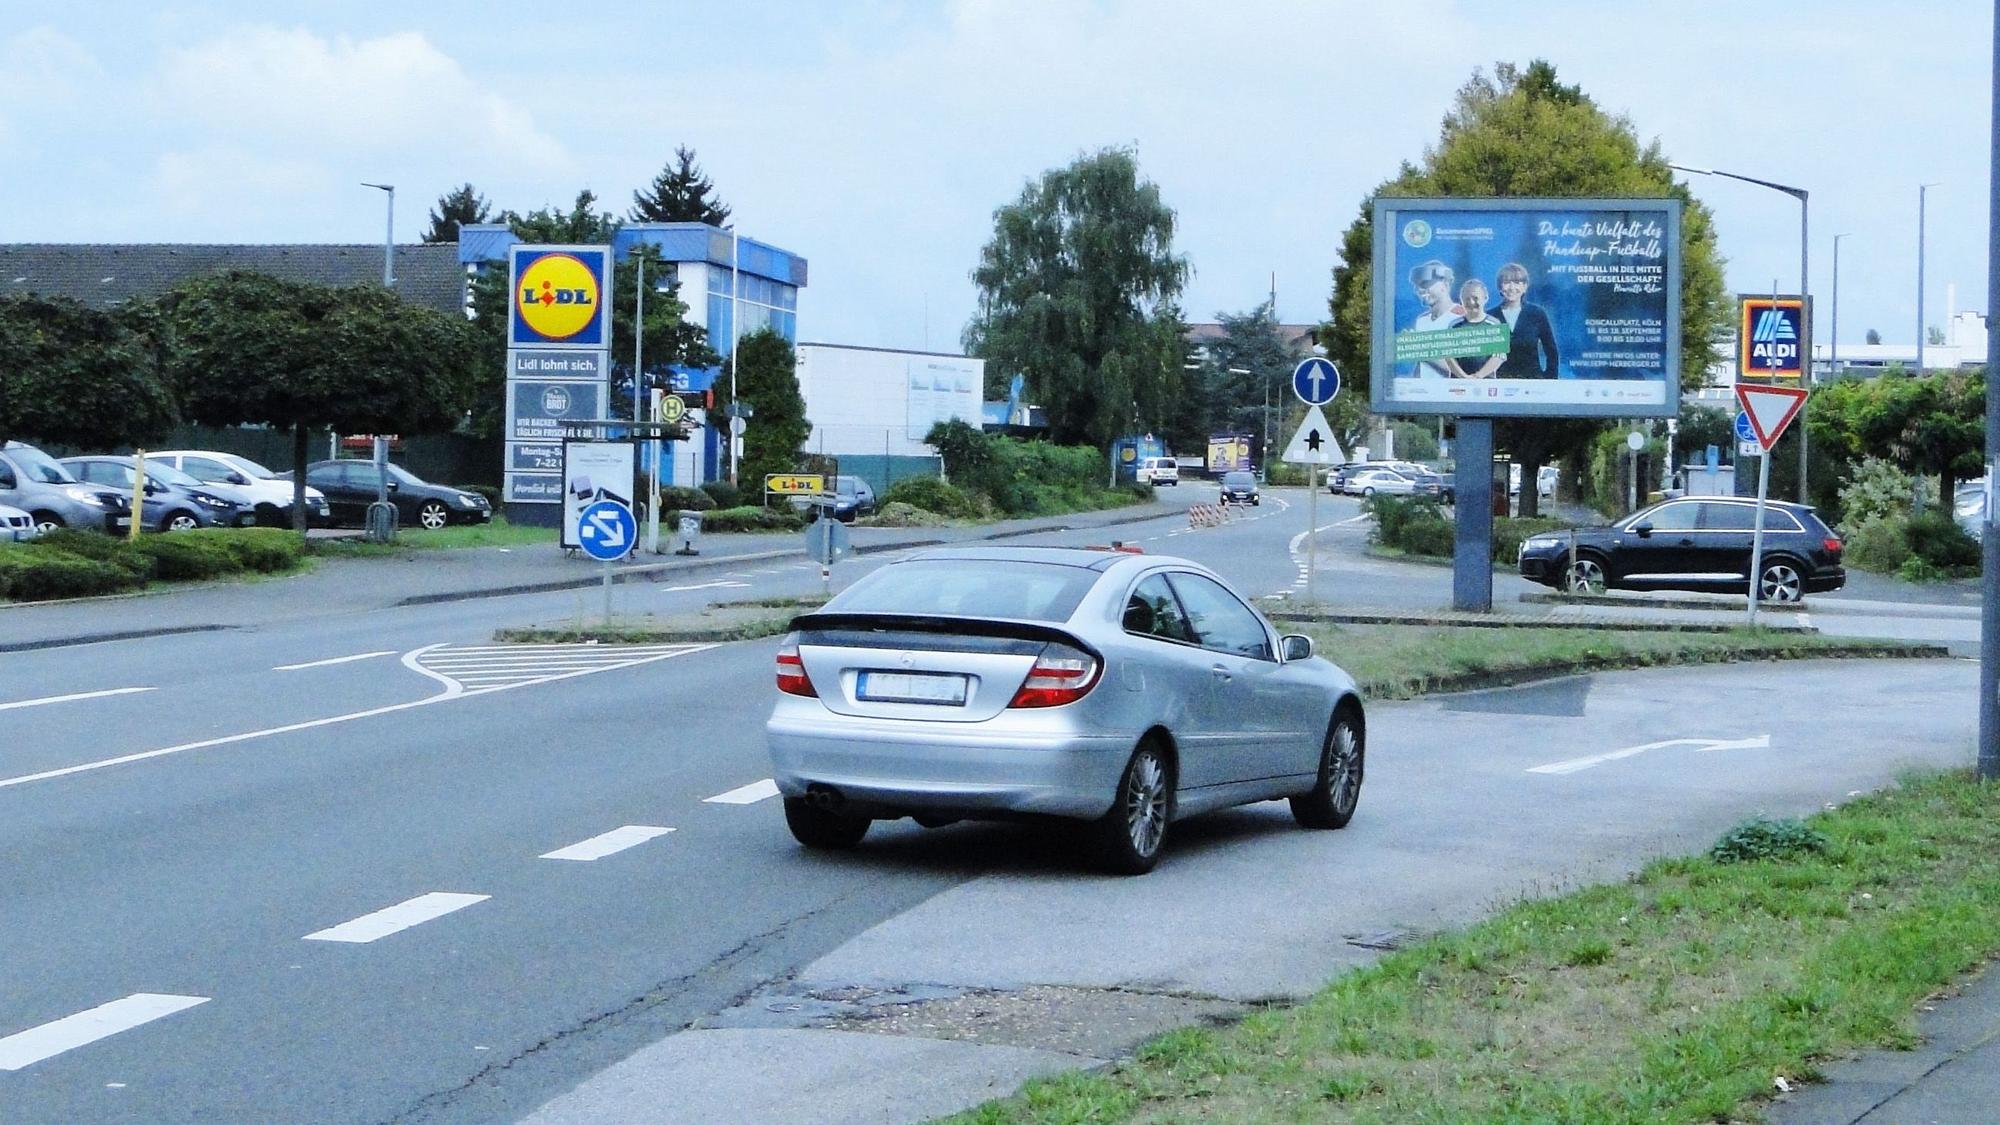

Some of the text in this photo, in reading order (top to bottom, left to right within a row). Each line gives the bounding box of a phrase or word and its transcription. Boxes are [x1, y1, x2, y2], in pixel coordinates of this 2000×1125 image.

[1538, 220, 1663, 239] Die bunte Vielfalt des
[1568, 265, 1607, 273] FUSSBALL
[1609, 265, 1619, 273] IN
[1620, 265, 1634, 273] DIE
[1636, 265, 1662, 273] MITTE
[1577, 275, 1595, 283] DER
[523, 281, 592, 307] LIDL
[1642, 318, 1661, 326] KÖLN
[1621, 327, 1662, 335] SEPTEMBER
[1753, 343, 1796, 357] ALDI
[517, 359, 597, 371] Lidl lohnt sich.
[667, 402, 677, 414] H
[531, 419, 557, 427] BACKEN
[536, 458, 557, 467] 7-22
[782, 478, 813, 489] LIDL
